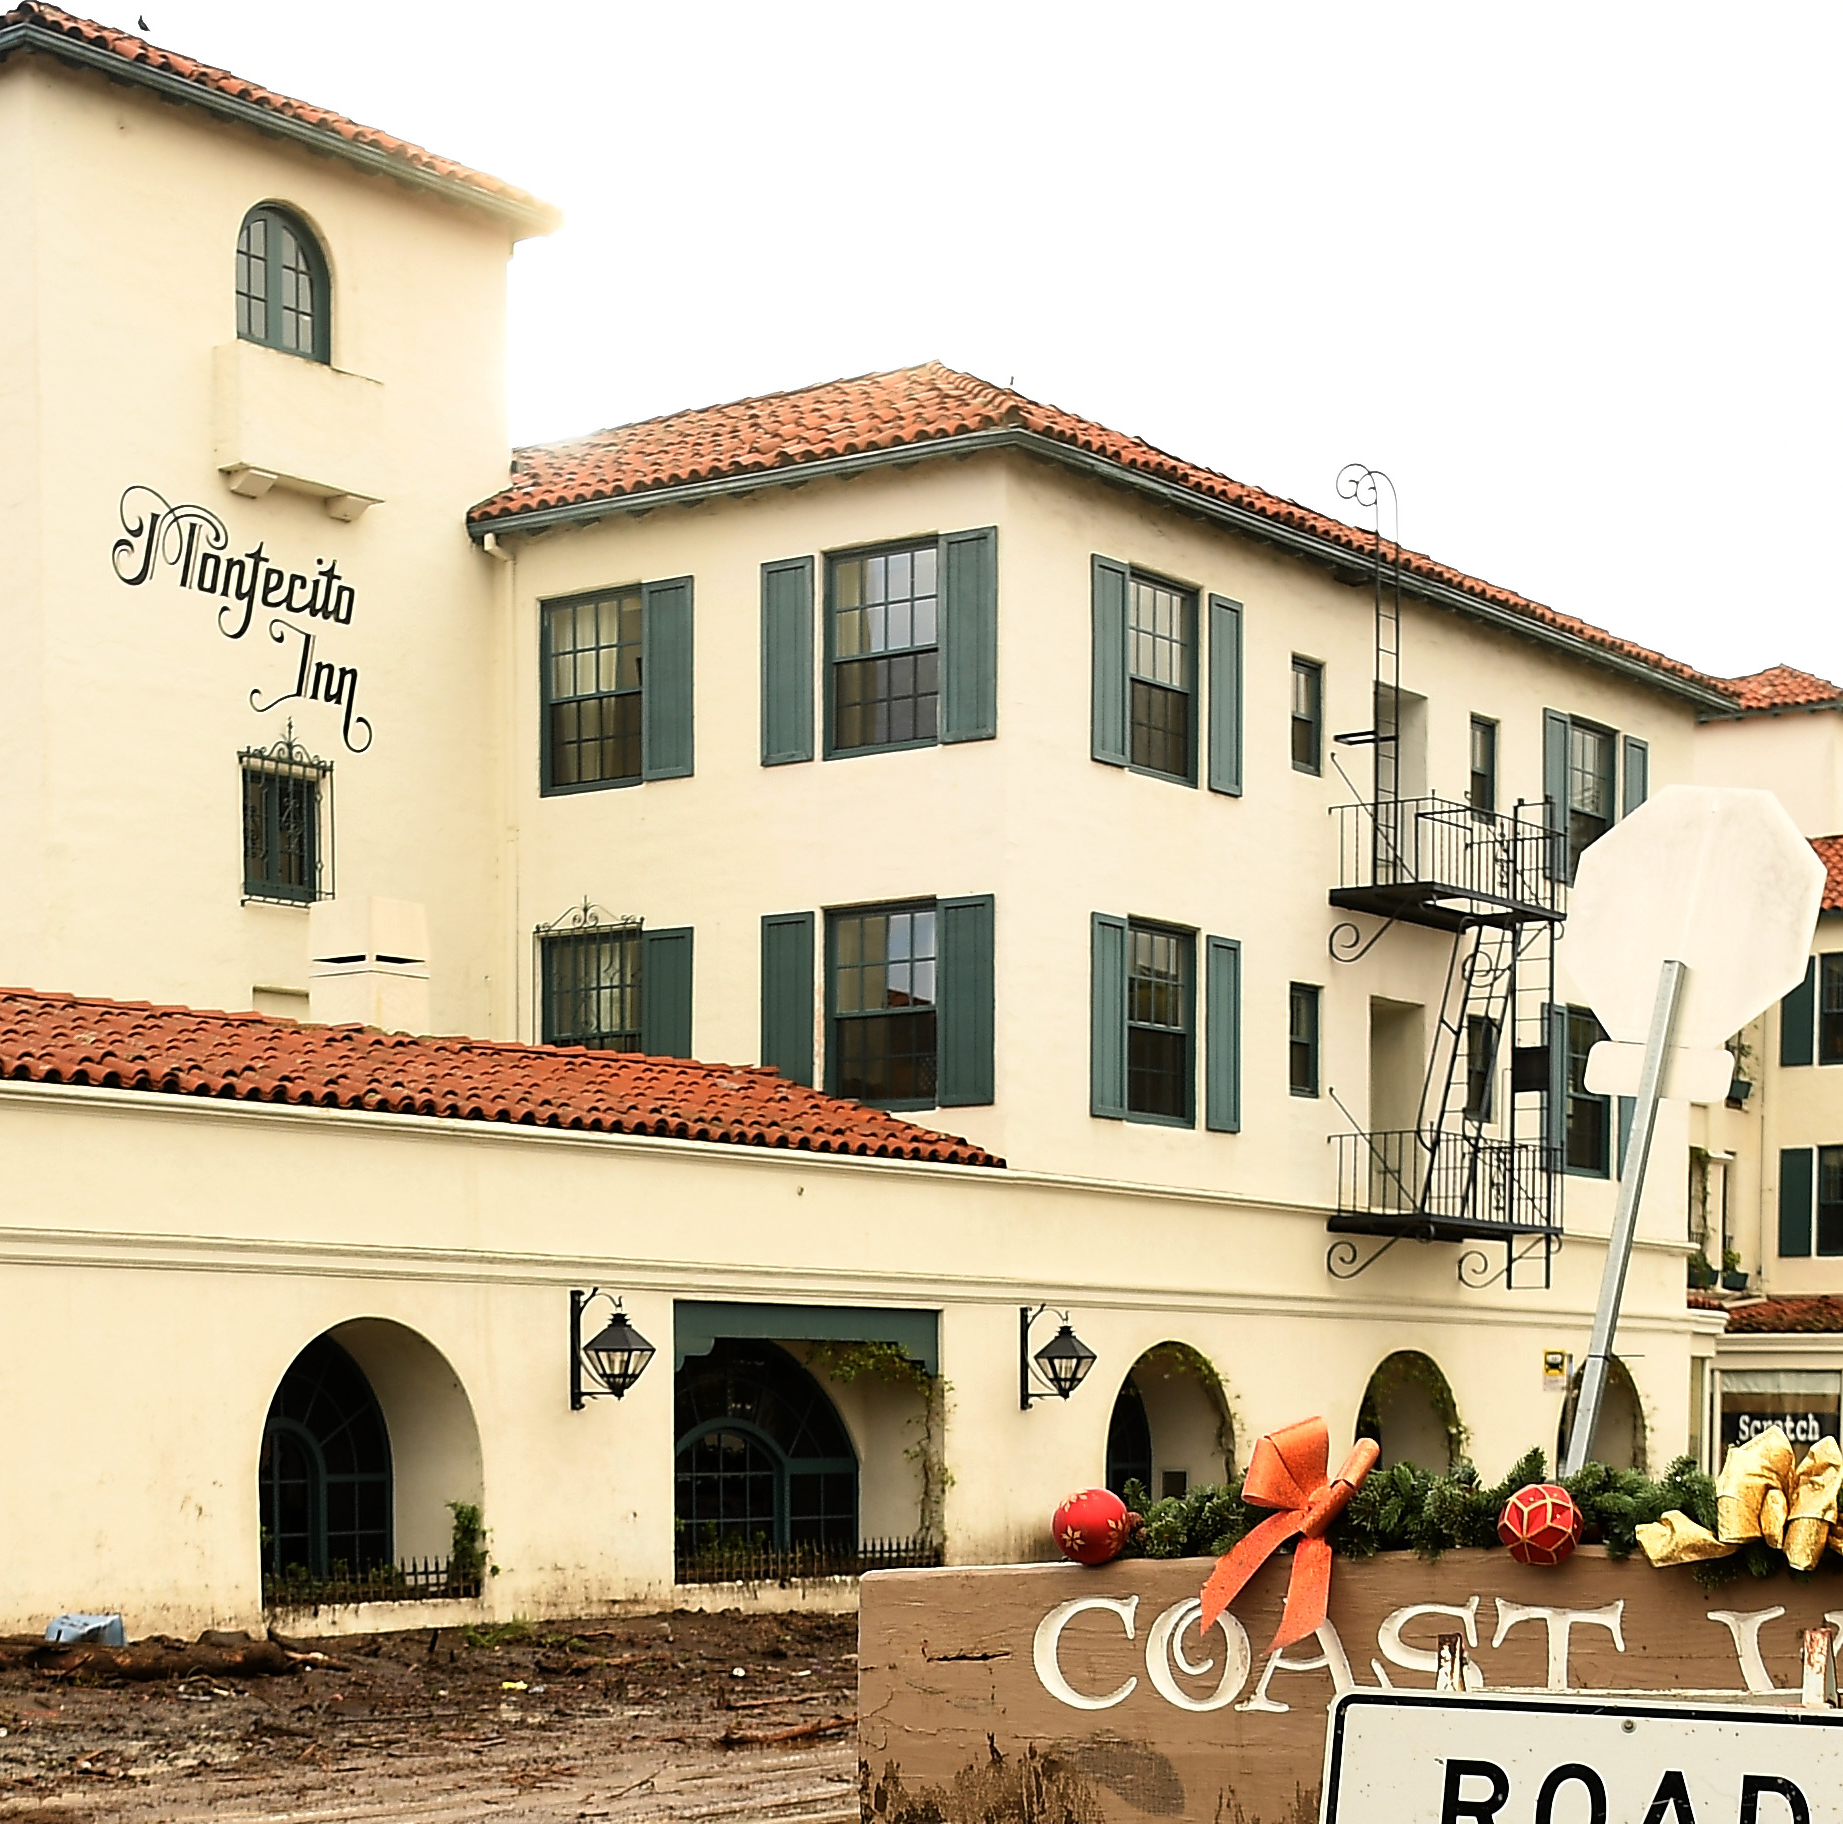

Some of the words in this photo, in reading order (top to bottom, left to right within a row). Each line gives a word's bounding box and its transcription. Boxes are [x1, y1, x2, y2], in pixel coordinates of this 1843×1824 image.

[112, 486, 355, 639] Montecito
[249, 619, 373, 753] Inn
[1033, 1594, 1626, 1713] COAST
